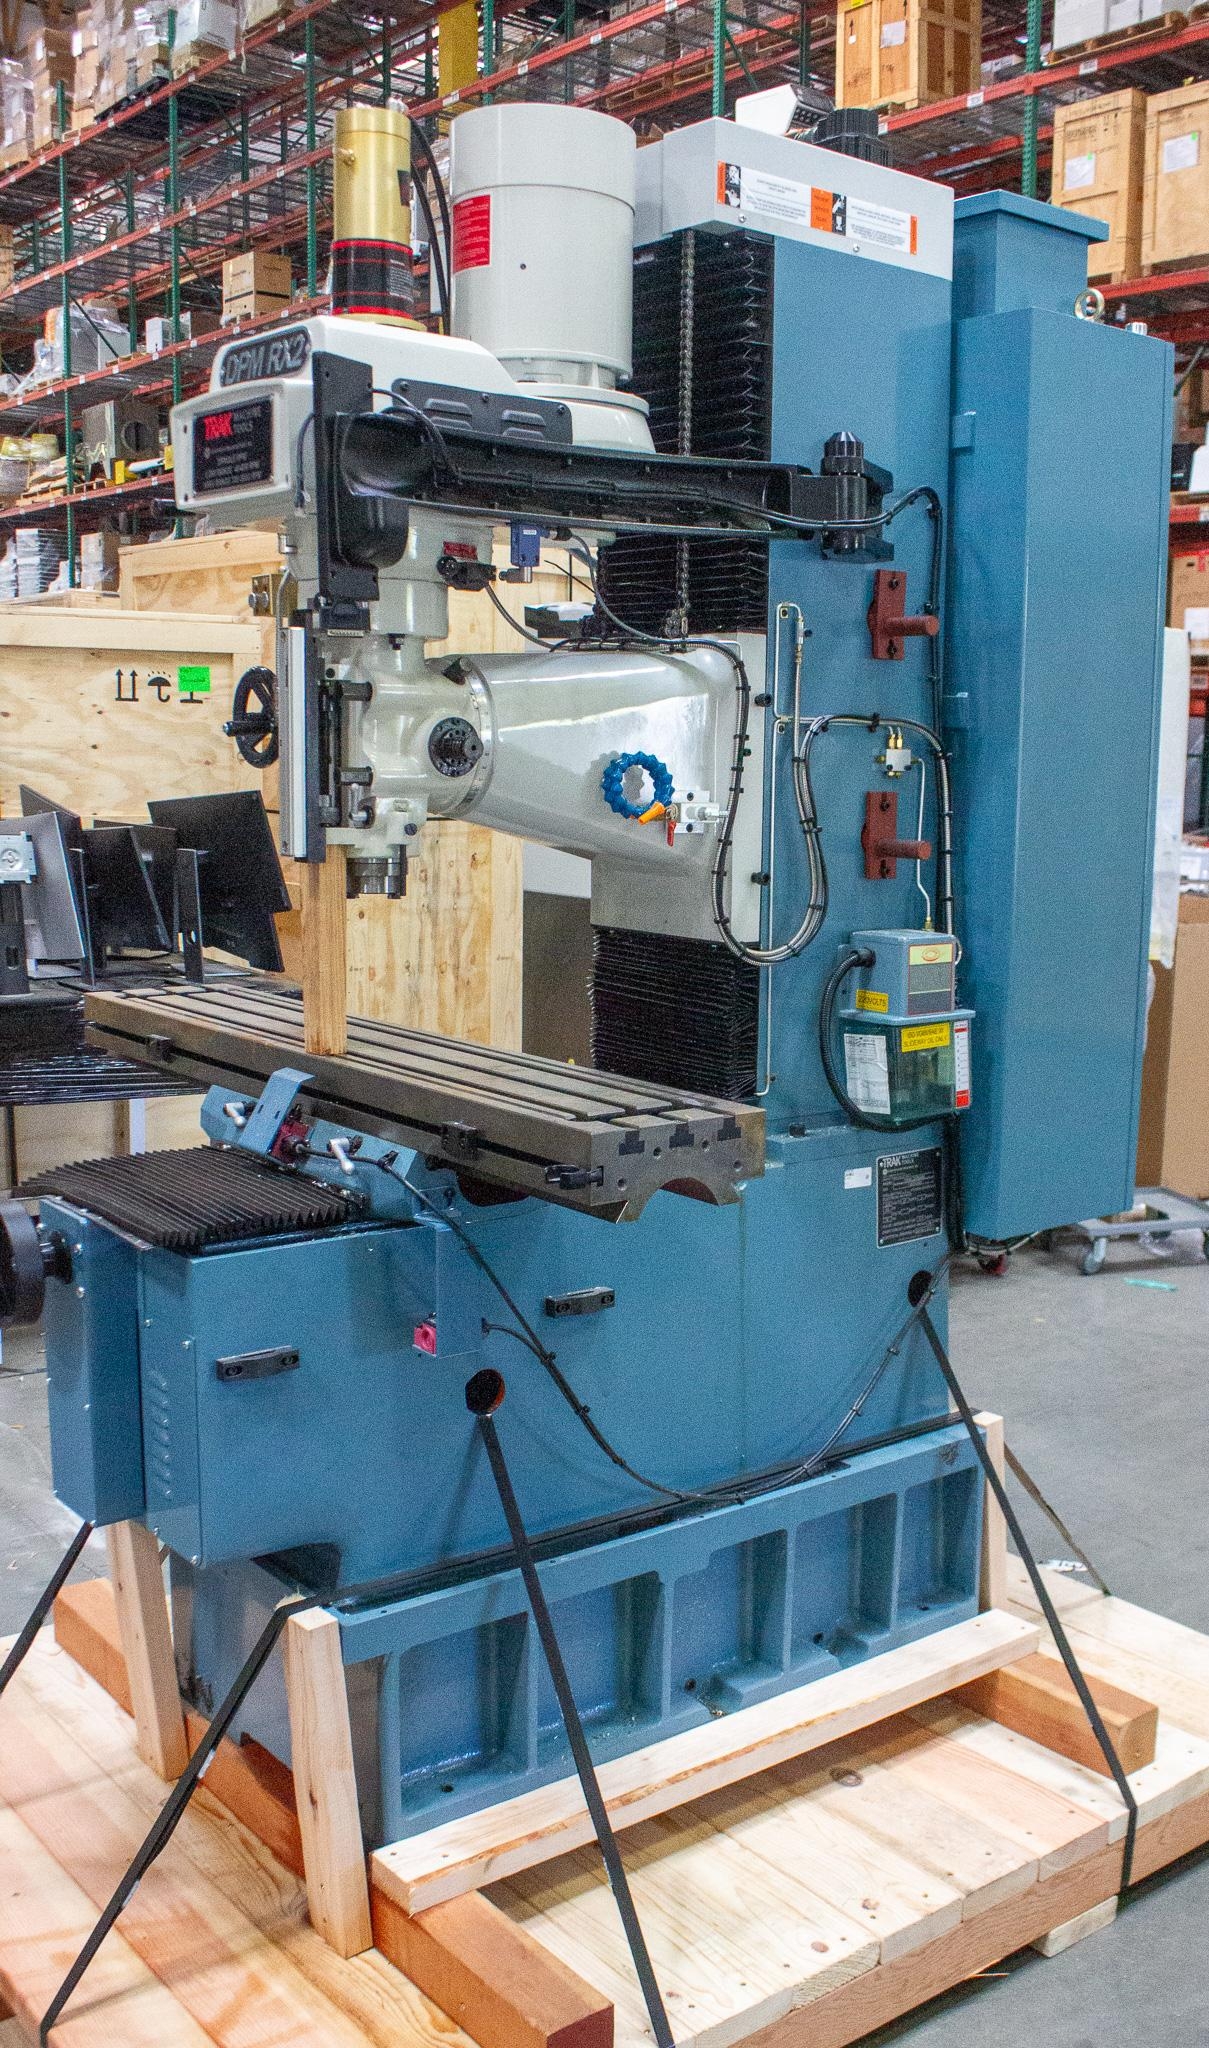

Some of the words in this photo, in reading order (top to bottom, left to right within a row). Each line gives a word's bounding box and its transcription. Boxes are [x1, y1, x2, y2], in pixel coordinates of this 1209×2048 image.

[225, 345, 264, 385] DPM
[267, 333, 306, 373] RX2
[882, 1156, 902, 1168] TRAK
